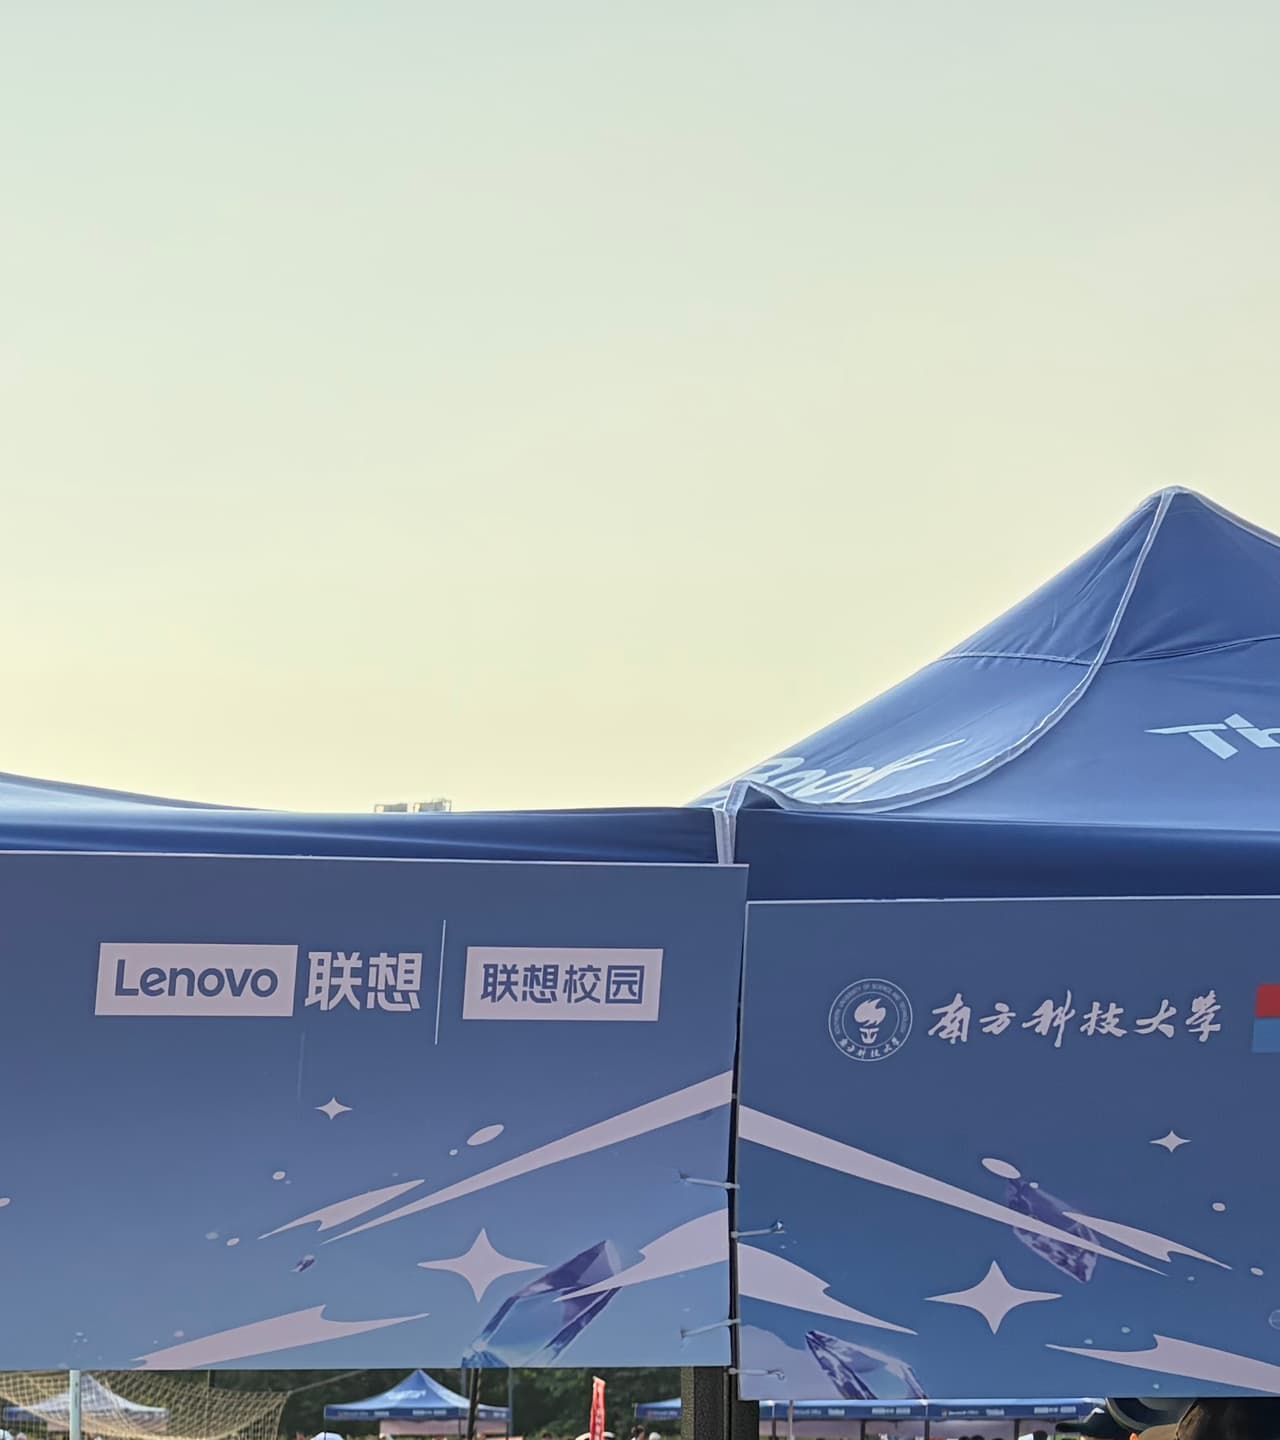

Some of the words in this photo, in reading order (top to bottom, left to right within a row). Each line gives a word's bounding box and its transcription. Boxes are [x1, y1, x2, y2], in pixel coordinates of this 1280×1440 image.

[115, 958, 278, 999] Lenovo
[304, 951, 423, 1012] 联想
[480, 962, 645, 1005] 联想校园
[927, 989, 1222, 1048] 南方科技大学
